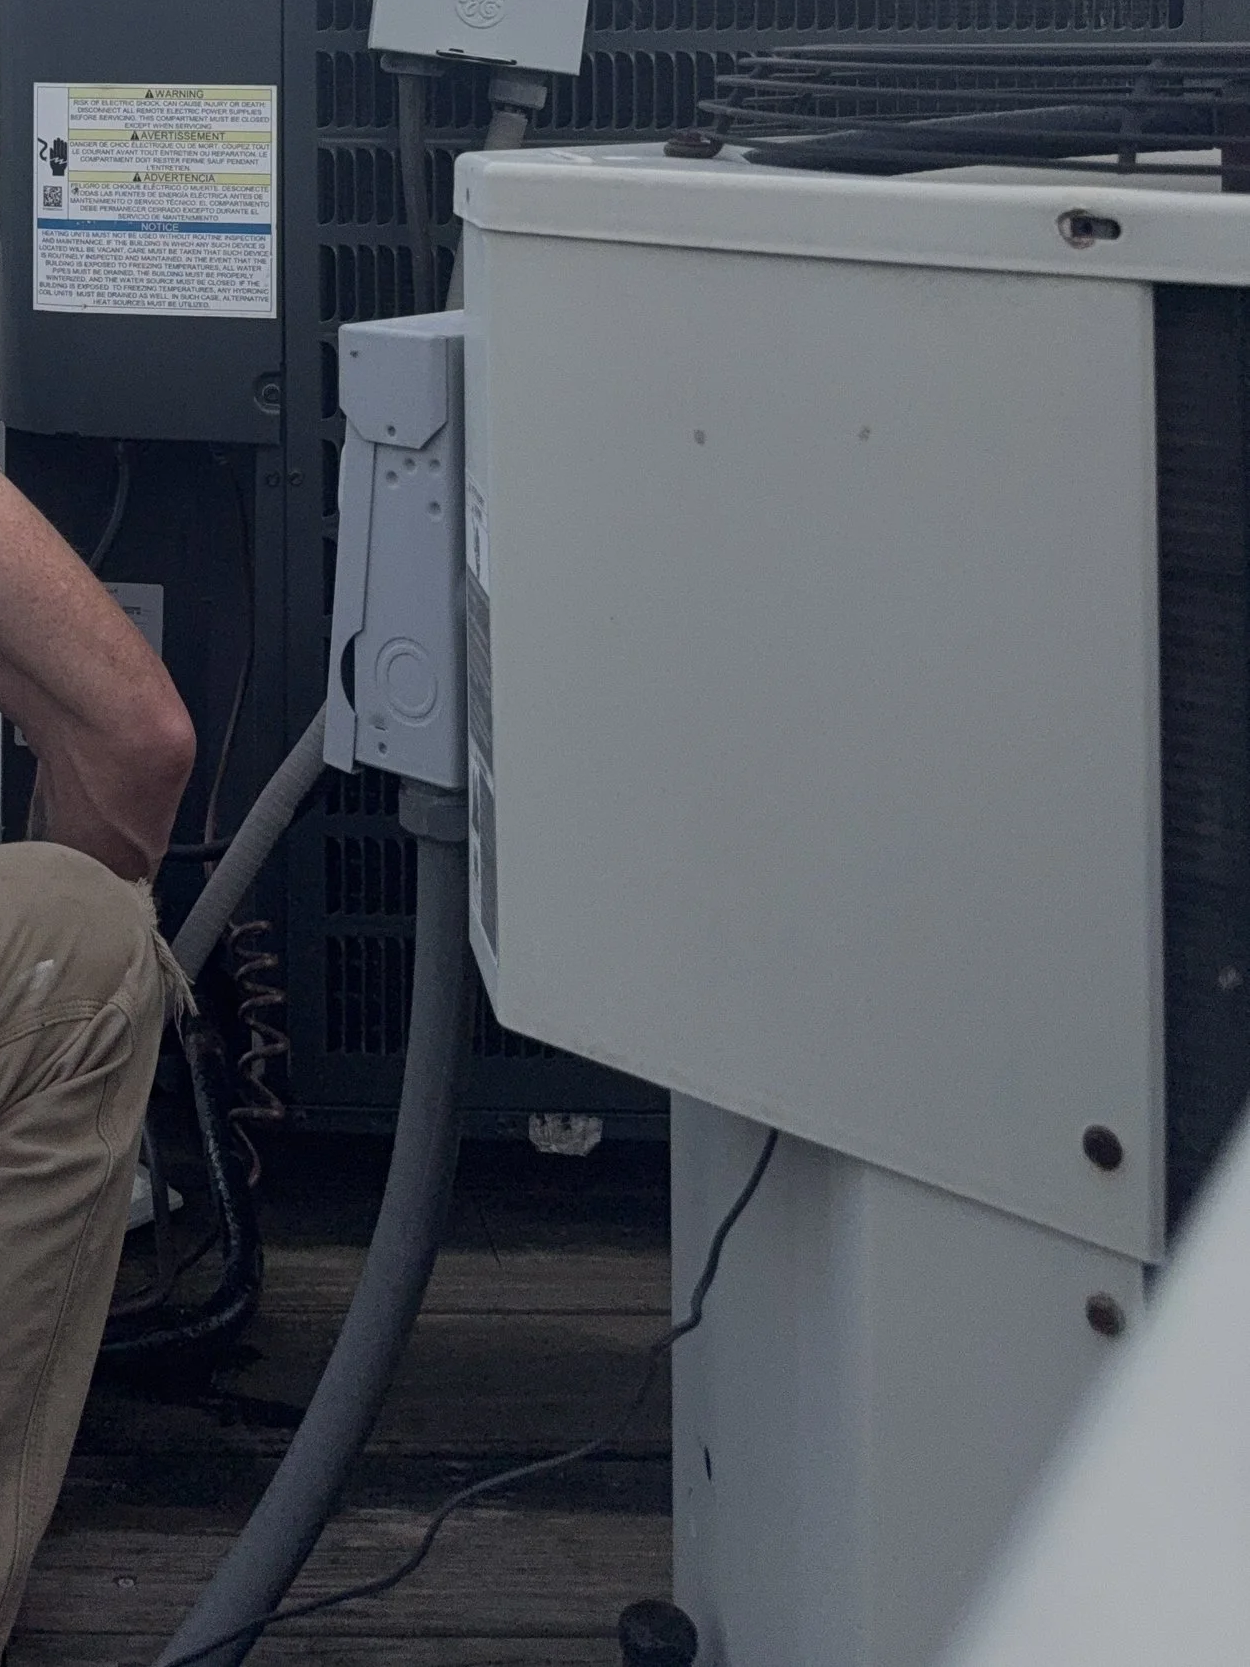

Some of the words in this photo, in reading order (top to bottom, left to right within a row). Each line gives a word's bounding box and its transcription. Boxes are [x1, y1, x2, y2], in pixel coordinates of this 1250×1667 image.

[155, 90, 204, 98] WARNING
[140, 131, 224, 140] AVERTISSEMENT
[143, 173, 215, 183] ADVERTENCIA
[141, 222, 178, 231] NOTICE
